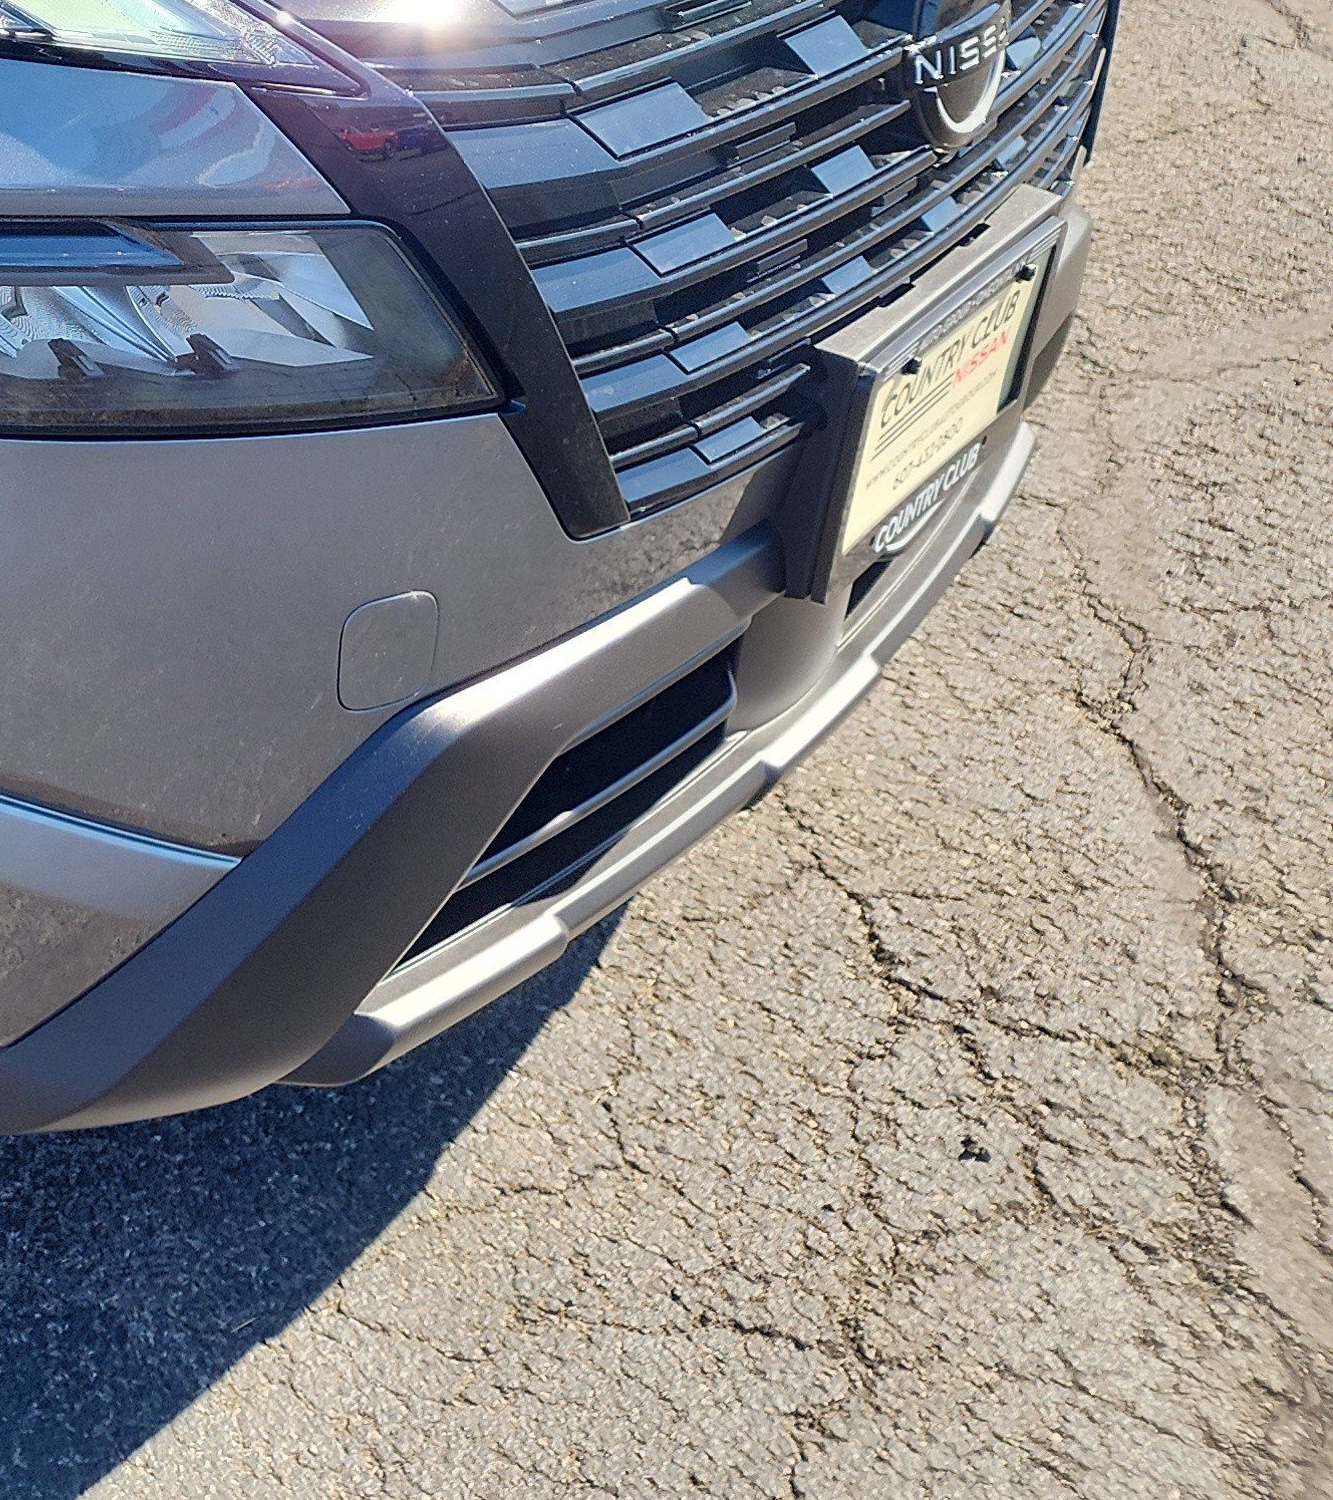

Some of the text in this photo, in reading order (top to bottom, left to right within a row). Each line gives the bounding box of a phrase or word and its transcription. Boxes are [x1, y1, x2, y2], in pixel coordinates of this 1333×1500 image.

[914, 15, 1010, 86] NISS
[881, 327, 973, 428] COUNTRY
[971, 289, 1021, 349] CLUB
[951, 326, 1011, 386] NISSAN
[873, 441, 982, 553] COUNTRY CLUB
